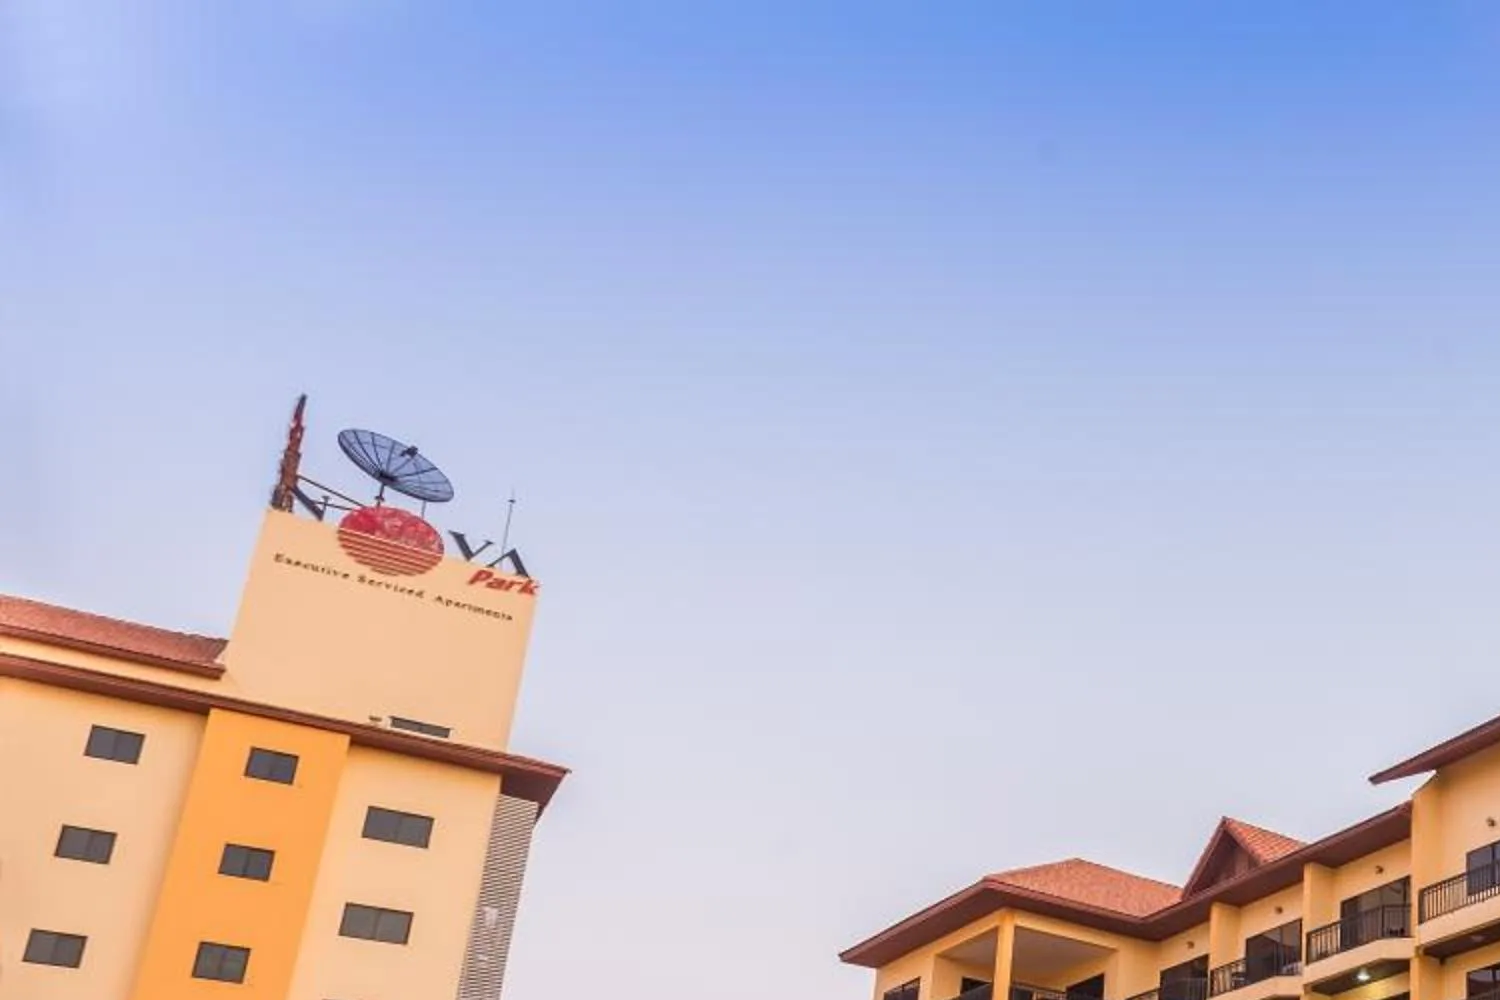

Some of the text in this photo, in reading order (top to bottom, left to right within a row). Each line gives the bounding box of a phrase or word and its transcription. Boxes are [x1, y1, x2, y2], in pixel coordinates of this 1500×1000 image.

[273, 553, 350, 579] Executive
[357, 574, 425, 599] Serviced
[468, 569, 540, 596] Park
